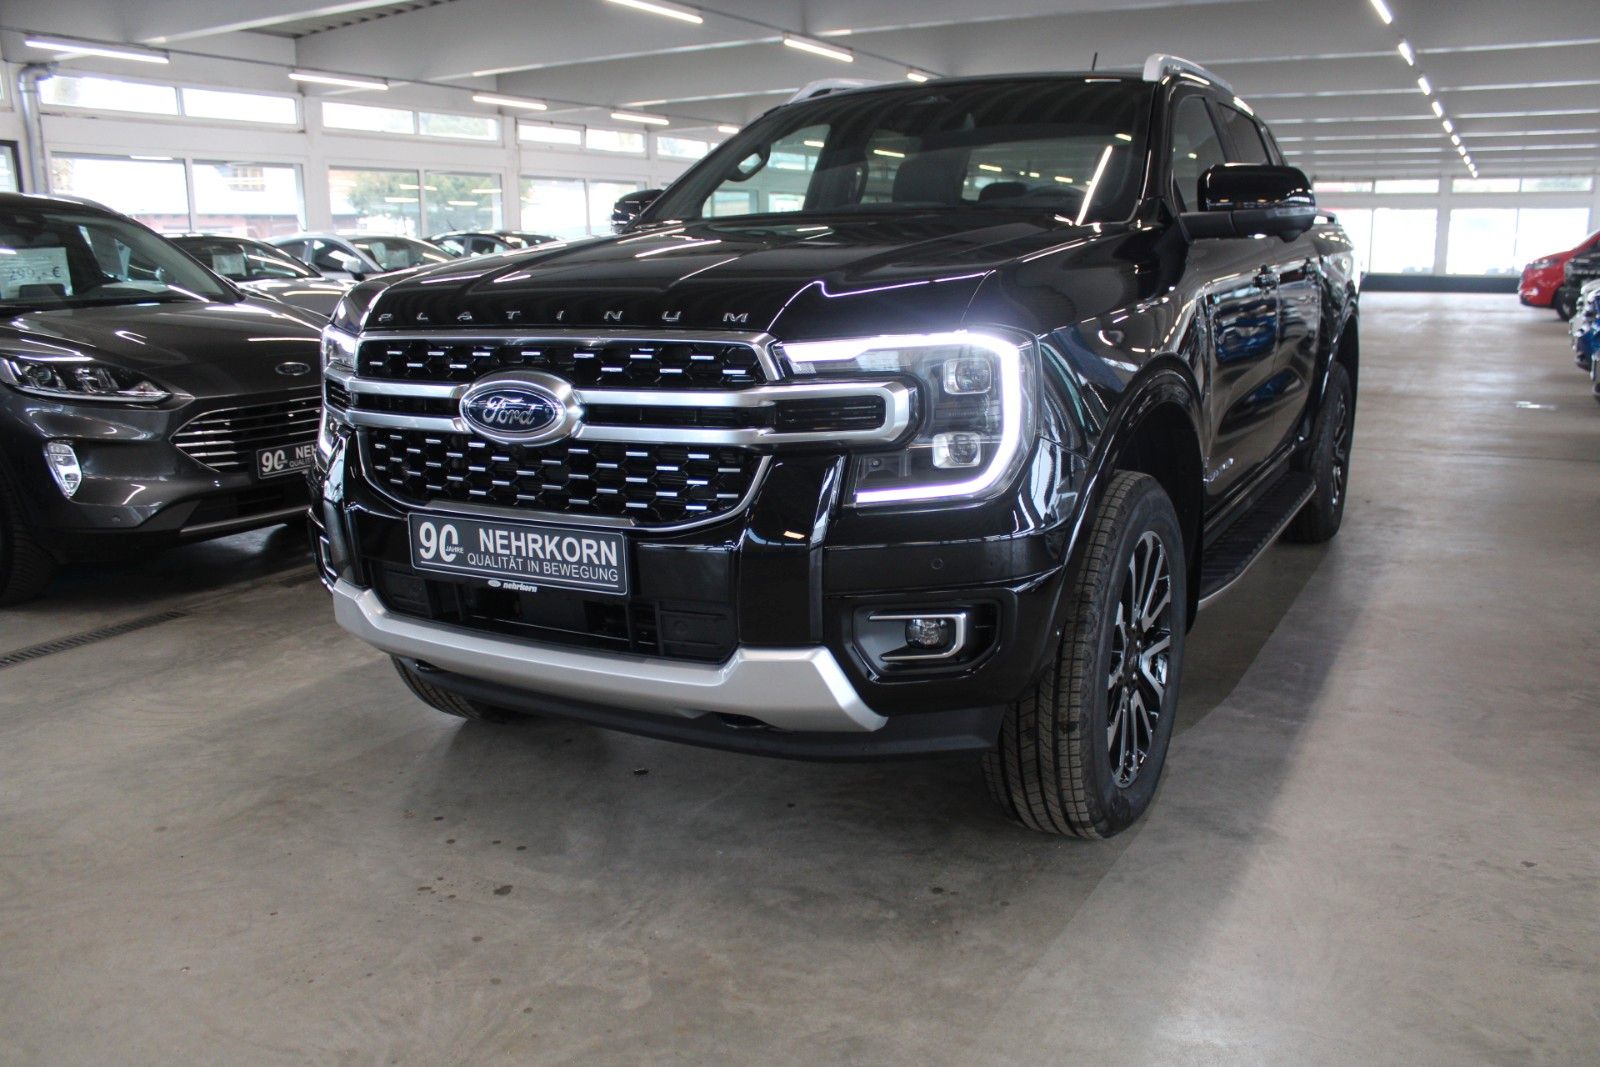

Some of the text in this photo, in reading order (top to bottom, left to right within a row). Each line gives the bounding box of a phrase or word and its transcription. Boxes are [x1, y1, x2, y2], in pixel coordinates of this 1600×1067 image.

[378, 310, 749, 323] PLATINUM
[482, 396, 537, 425] Ford
[419, 521, 618, 567] 90 NEHRKORN
[467, 552, 619, 582] QUALITÄT IN BEWEGUNG
[502, 582, 538, 593] nehrkorn
